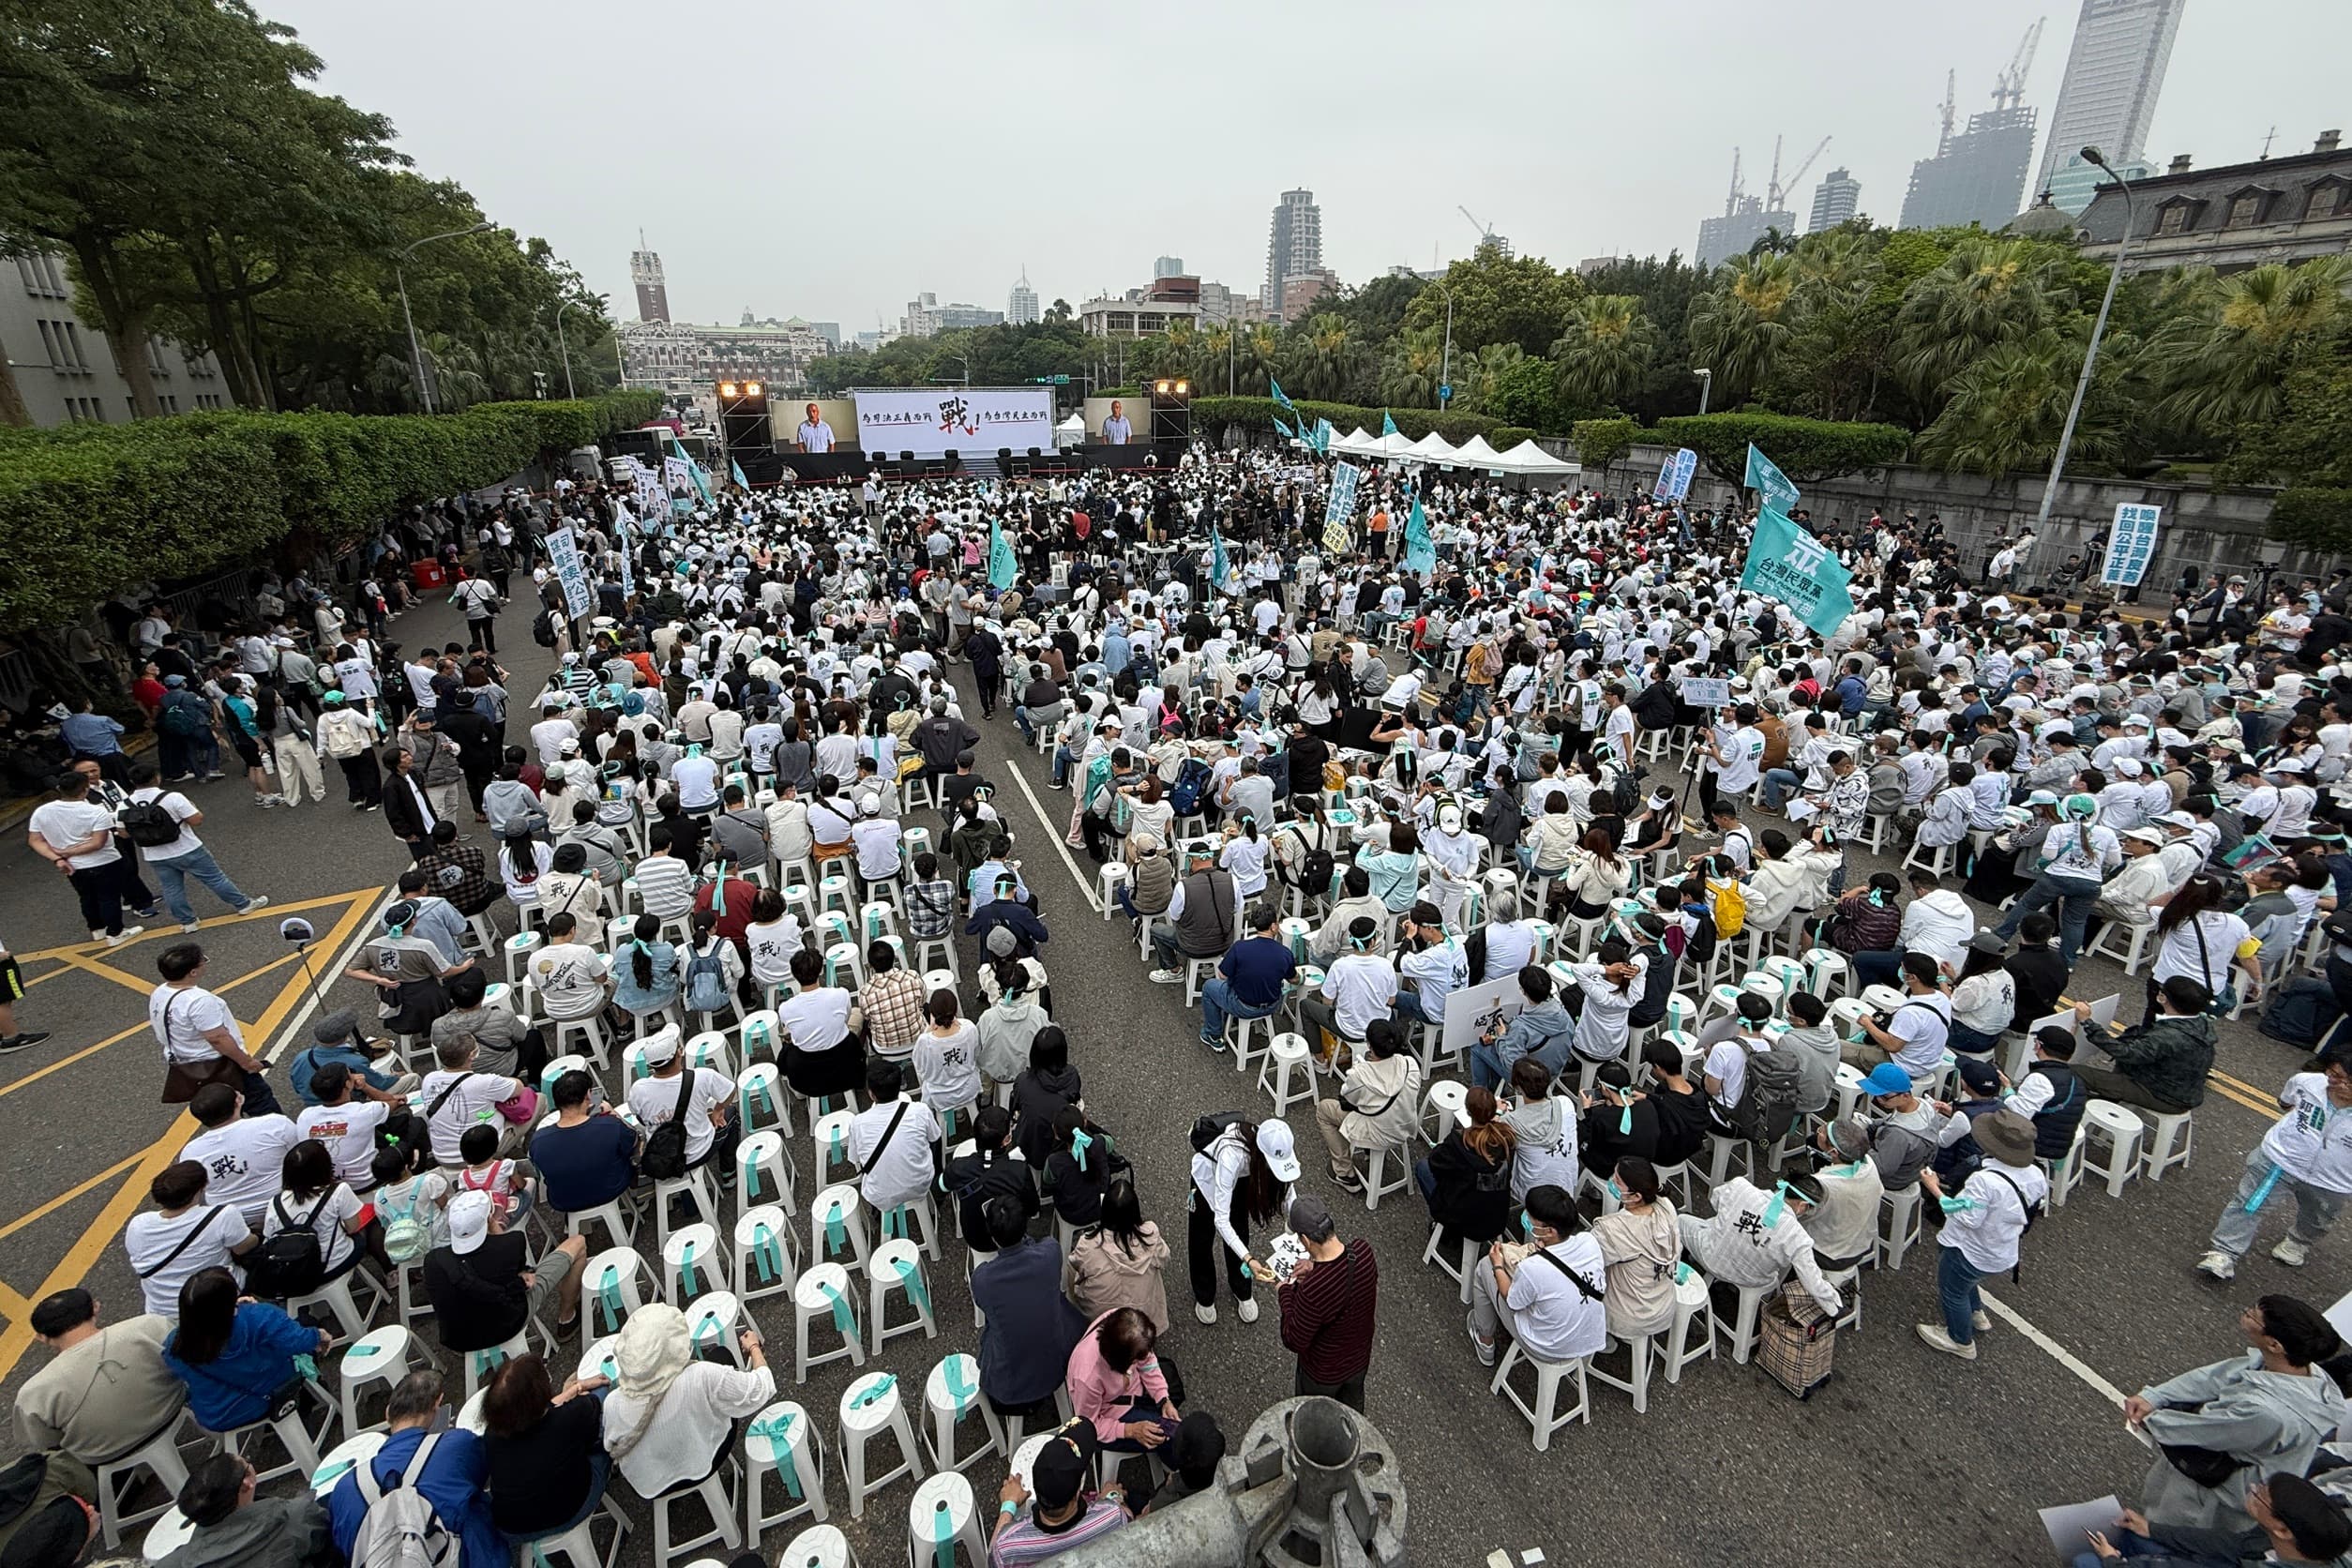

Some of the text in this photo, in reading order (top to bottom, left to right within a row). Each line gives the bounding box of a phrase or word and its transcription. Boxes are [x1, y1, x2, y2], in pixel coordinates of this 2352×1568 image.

[939, 397, 980, 436] 戰!
[2106, 506, 2138, 581] 找回公平正義
[1759, 558, 1824, 600] 台灣民眾黨
[550, 881, 571, 897] 戰!
[381, 950, 398, 970] 戰
[759, 941, 780, 957] 戰!
[942, 1048, 968, 1066] 戰!
[211, 1154, 249, 1180] 戰!
[1733, 1210, 1772, 1247] 戰!
